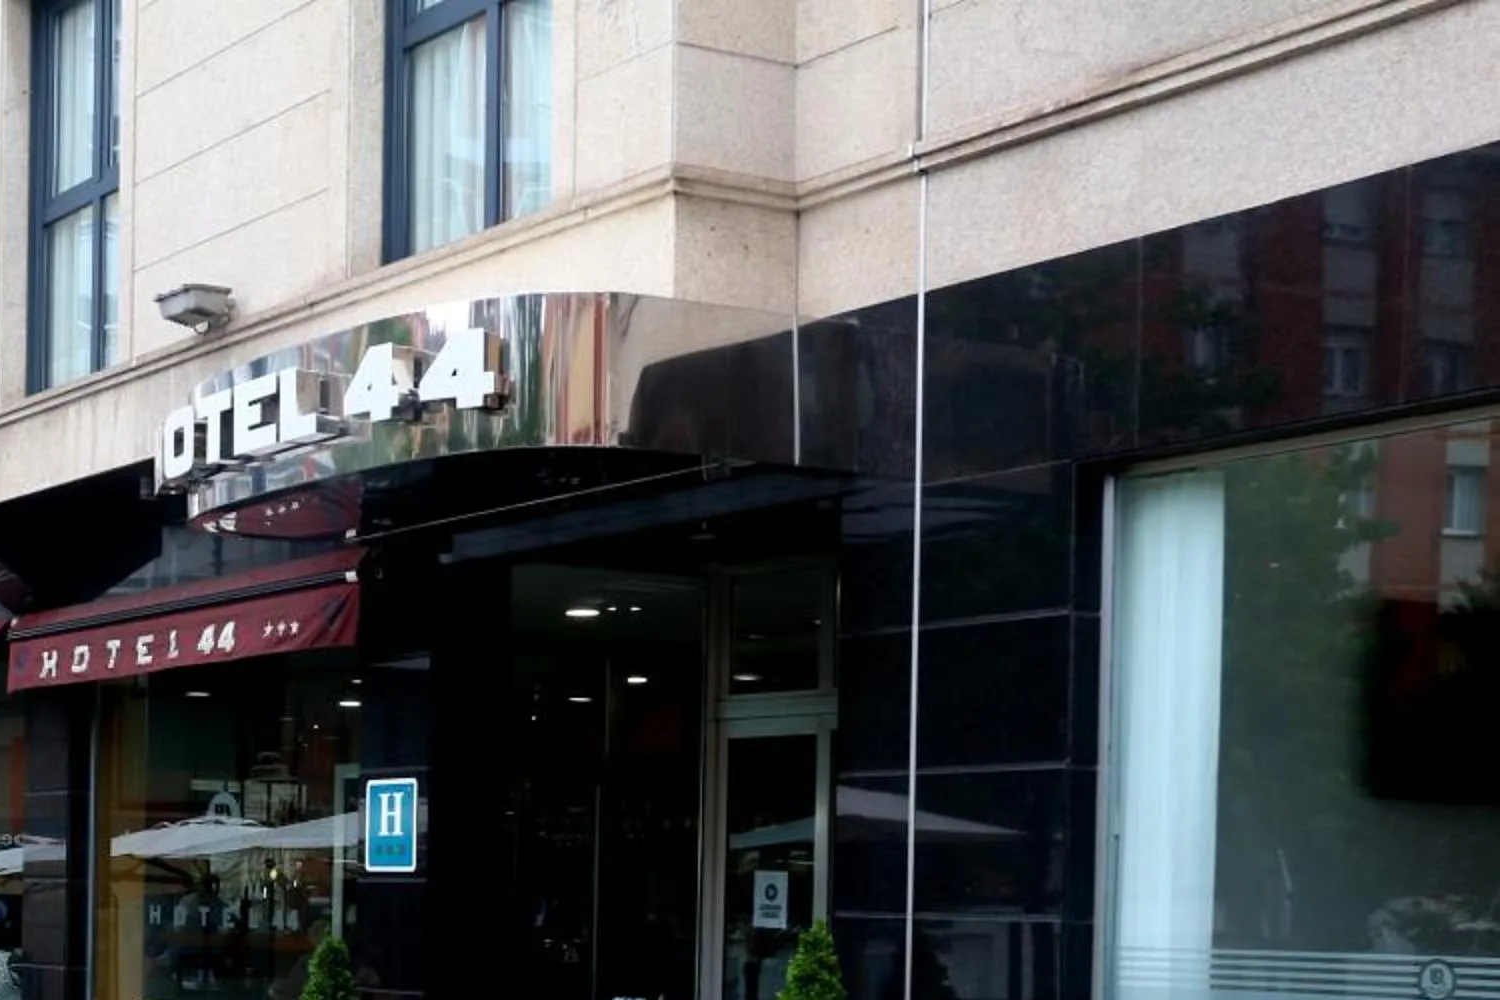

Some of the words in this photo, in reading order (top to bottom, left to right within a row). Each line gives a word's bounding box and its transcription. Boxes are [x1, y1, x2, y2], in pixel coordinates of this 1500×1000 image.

[157, 368, 317, 486] OTEL
[344, 327, 495, 421] 44
[38, 628, 180, 679] HOTEL
[196, 620, 236, 655] 44
[377, 791, 405, 837] H
